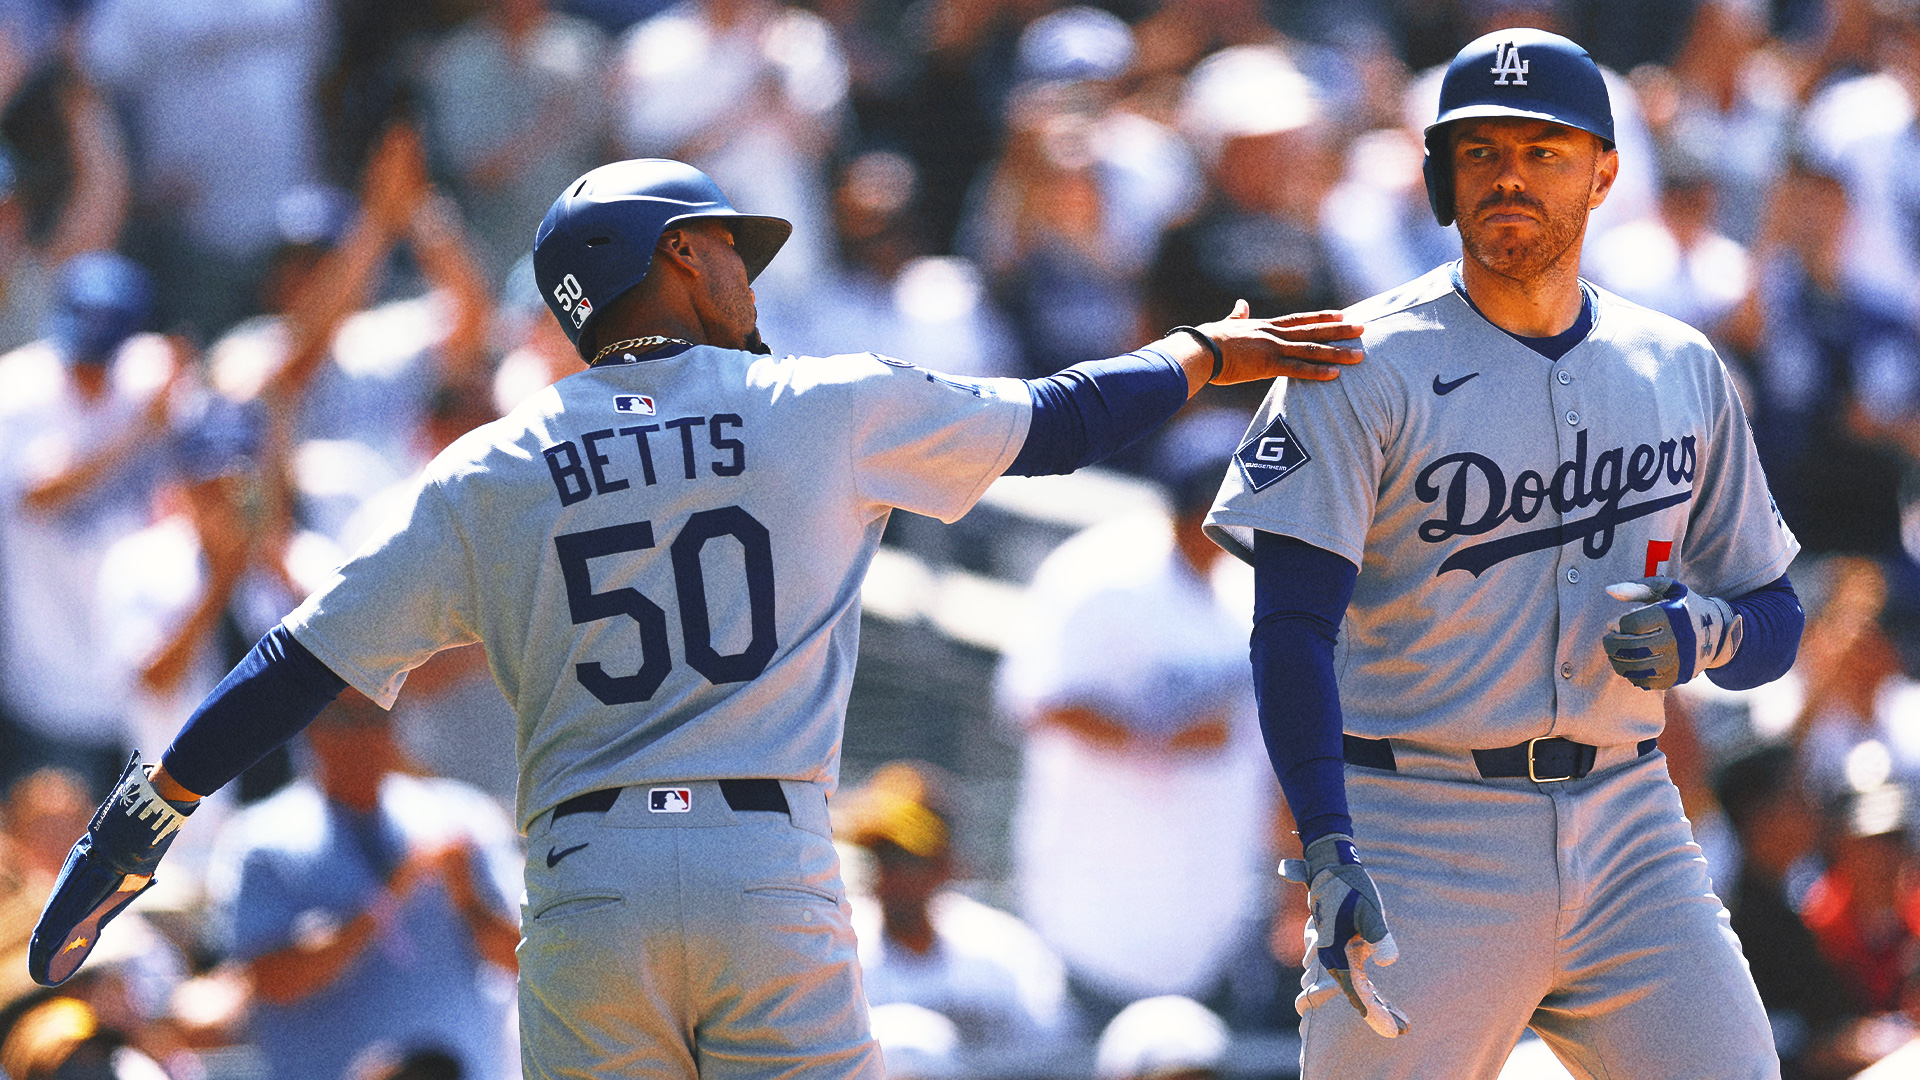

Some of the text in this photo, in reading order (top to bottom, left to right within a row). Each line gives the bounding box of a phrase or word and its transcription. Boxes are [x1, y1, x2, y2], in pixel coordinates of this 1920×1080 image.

[1490, 41, 1530, 86] LA
[553, 273, 582, 311] 50
[543, 413, 745, 507] BETTS
[1256, 437, 1286, 461] G
[1415, 428, 1697, 560] Dodgers
[554, 505, 779, 706] 50
